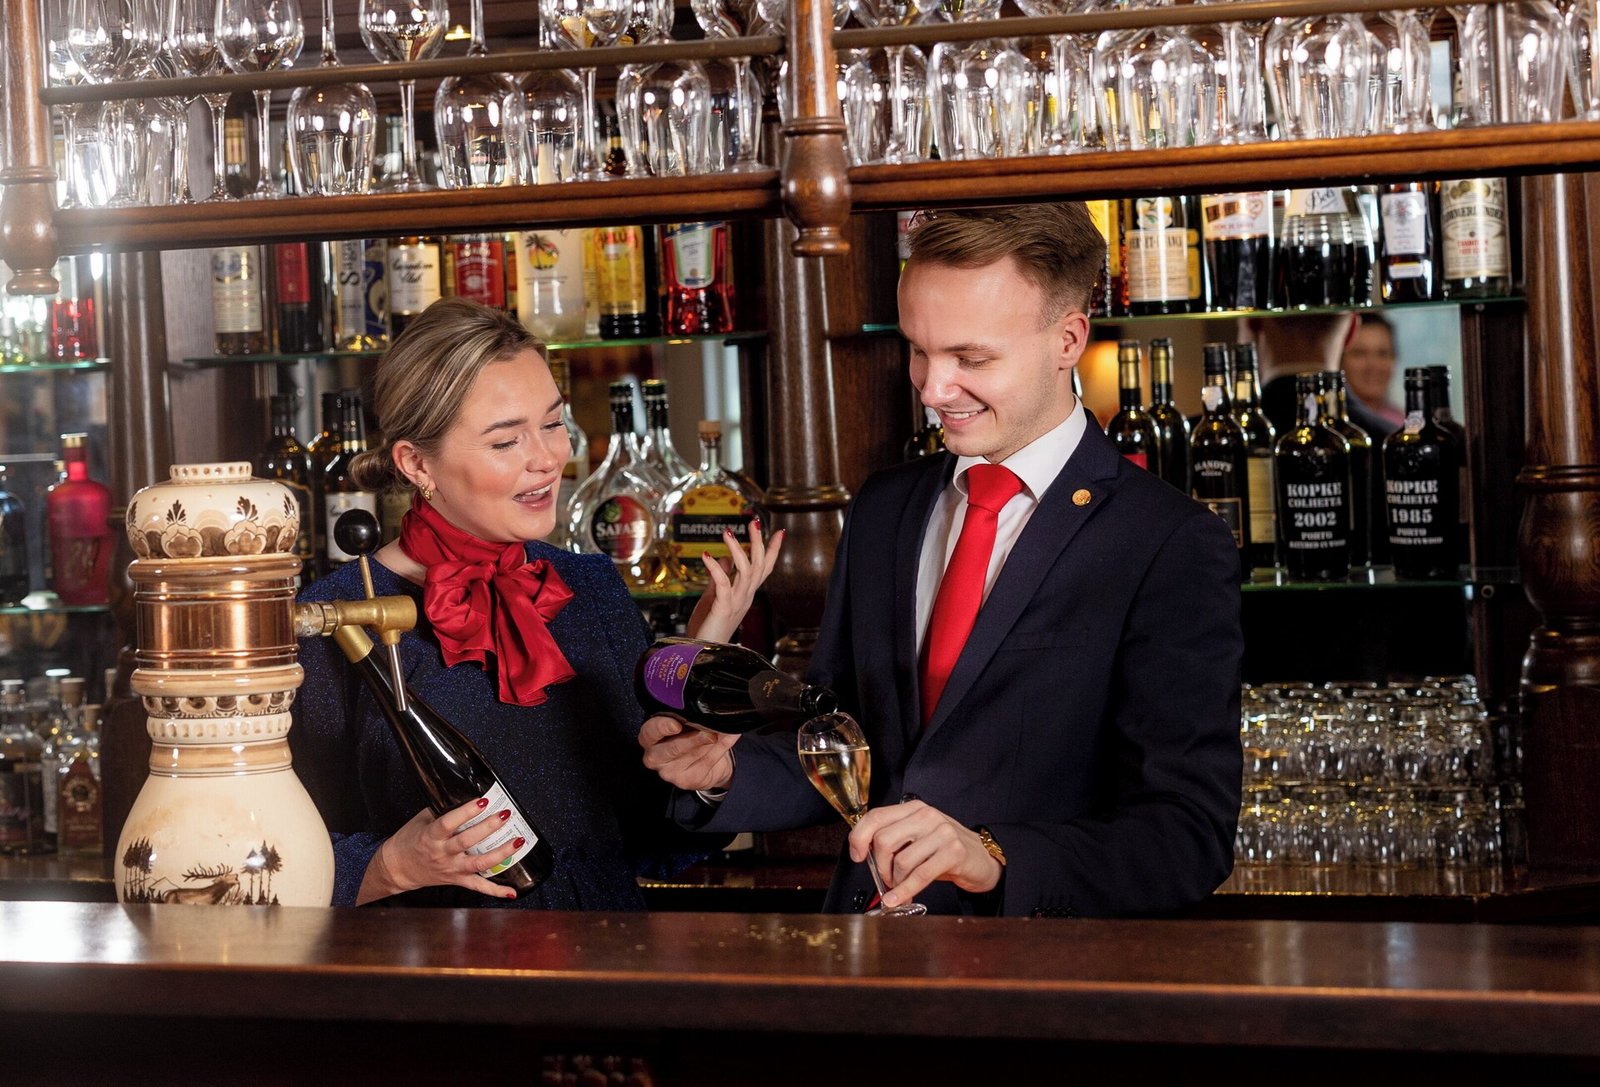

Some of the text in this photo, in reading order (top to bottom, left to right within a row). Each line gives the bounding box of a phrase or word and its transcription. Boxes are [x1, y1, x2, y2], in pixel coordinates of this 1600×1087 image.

[1286, 482, 1342, 497] KOPKE
[1386, 480, 1438, 494] KOPKE
[1287, 496, 1342, 509] COLHEITA
[1294, 511, 1337, 527] 2002
[1392, 508, 1433, 523] 1985
[679, 523, 746, 535] MATROESKA
[1301, 531, 1333, 540] PORTO
